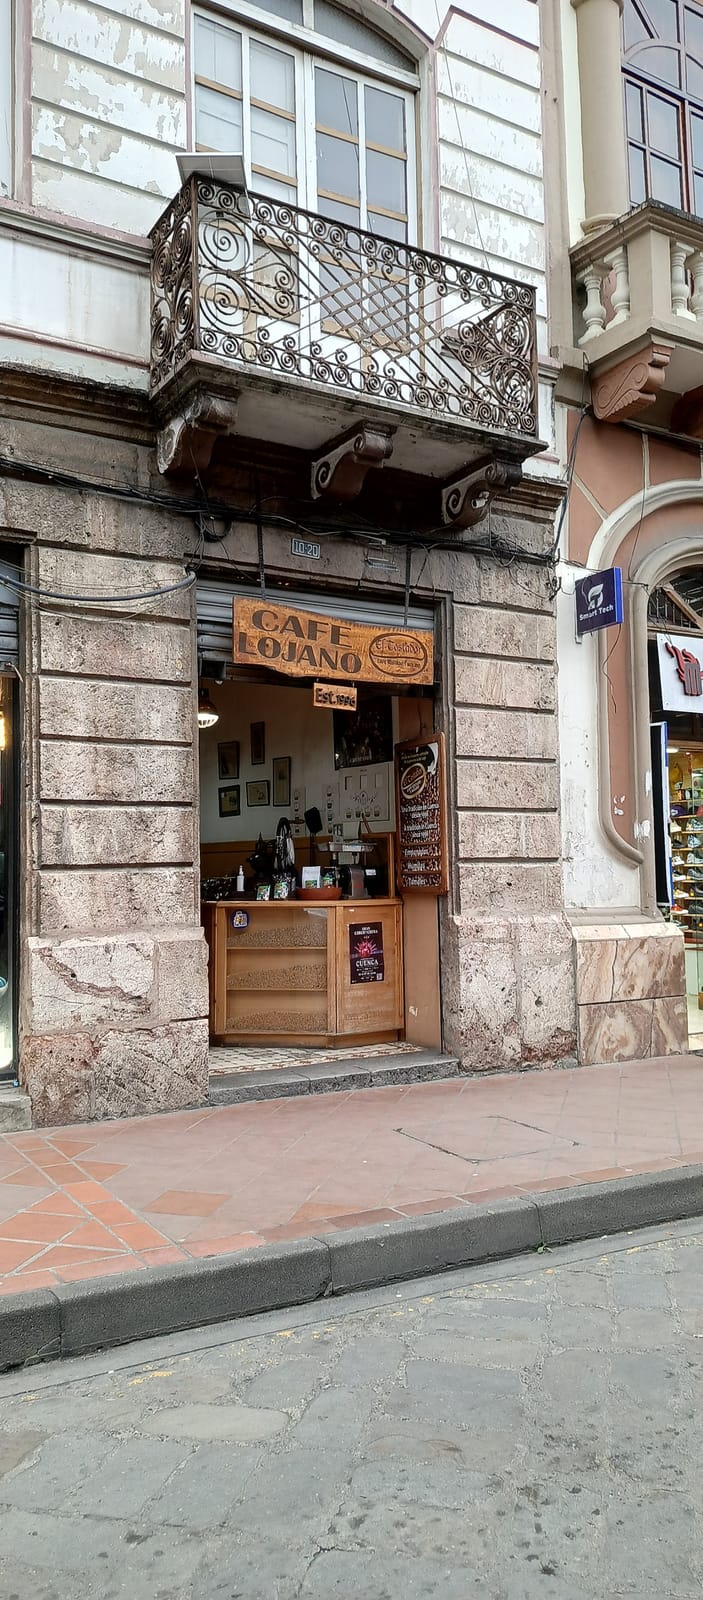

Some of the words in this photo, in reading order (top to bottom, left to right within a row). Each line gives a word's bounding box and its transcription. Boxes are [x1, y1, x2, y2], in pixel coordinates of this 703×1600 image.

[579, 609, 598, 621] Smart
[598, 604, 614, 615] Tech
[252, 609, 353, 648] CAFE
[238, 632, 362, 674] LOJANO
[355, 959, 379, 967] CUENCA
